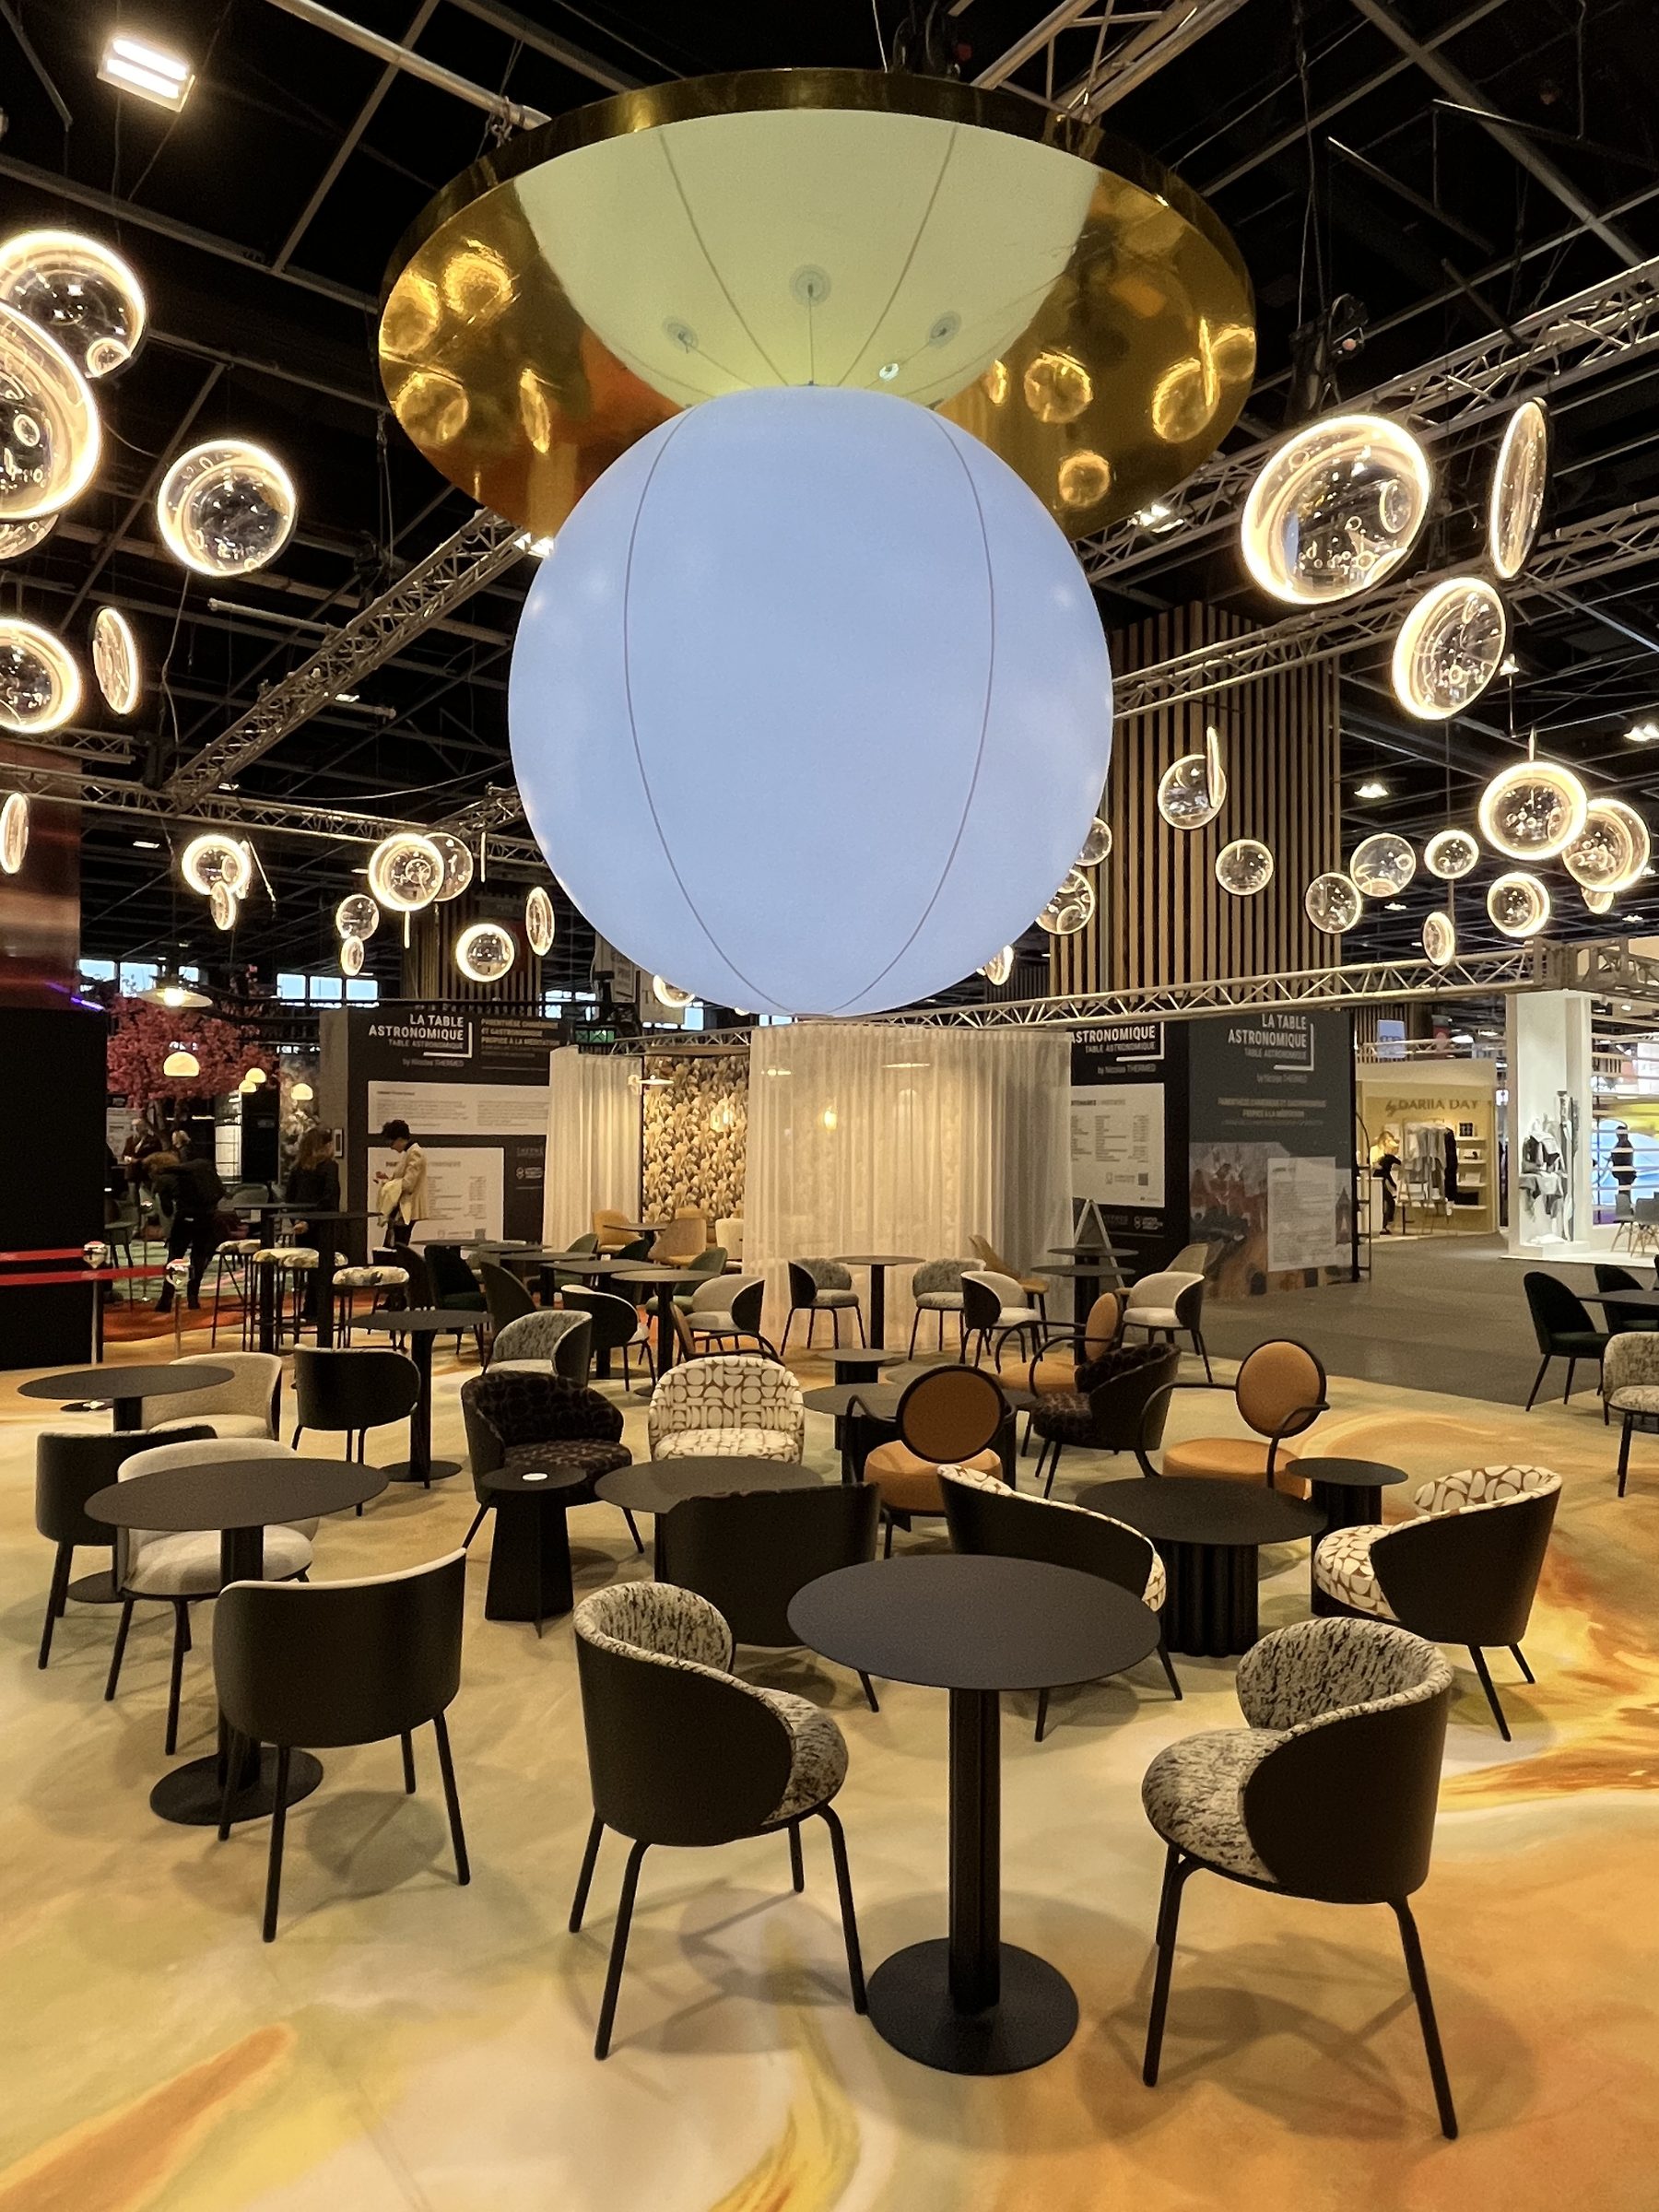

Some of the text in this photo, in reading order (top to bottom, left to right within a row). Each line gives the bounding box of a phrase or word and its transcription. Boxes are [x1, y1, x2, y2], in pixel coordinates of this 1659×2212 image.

[409, 1014, 465, 1028] LA TABLE
[1262, 1014, 1307, 1030] LA TABLE
[368, 1025, 465, 1041] ASTRONOMIQUE
[1228, 1029, 1307, 1048] ASTRONOMIQUE
[1449, 1100, 1478, 1110] DAY
